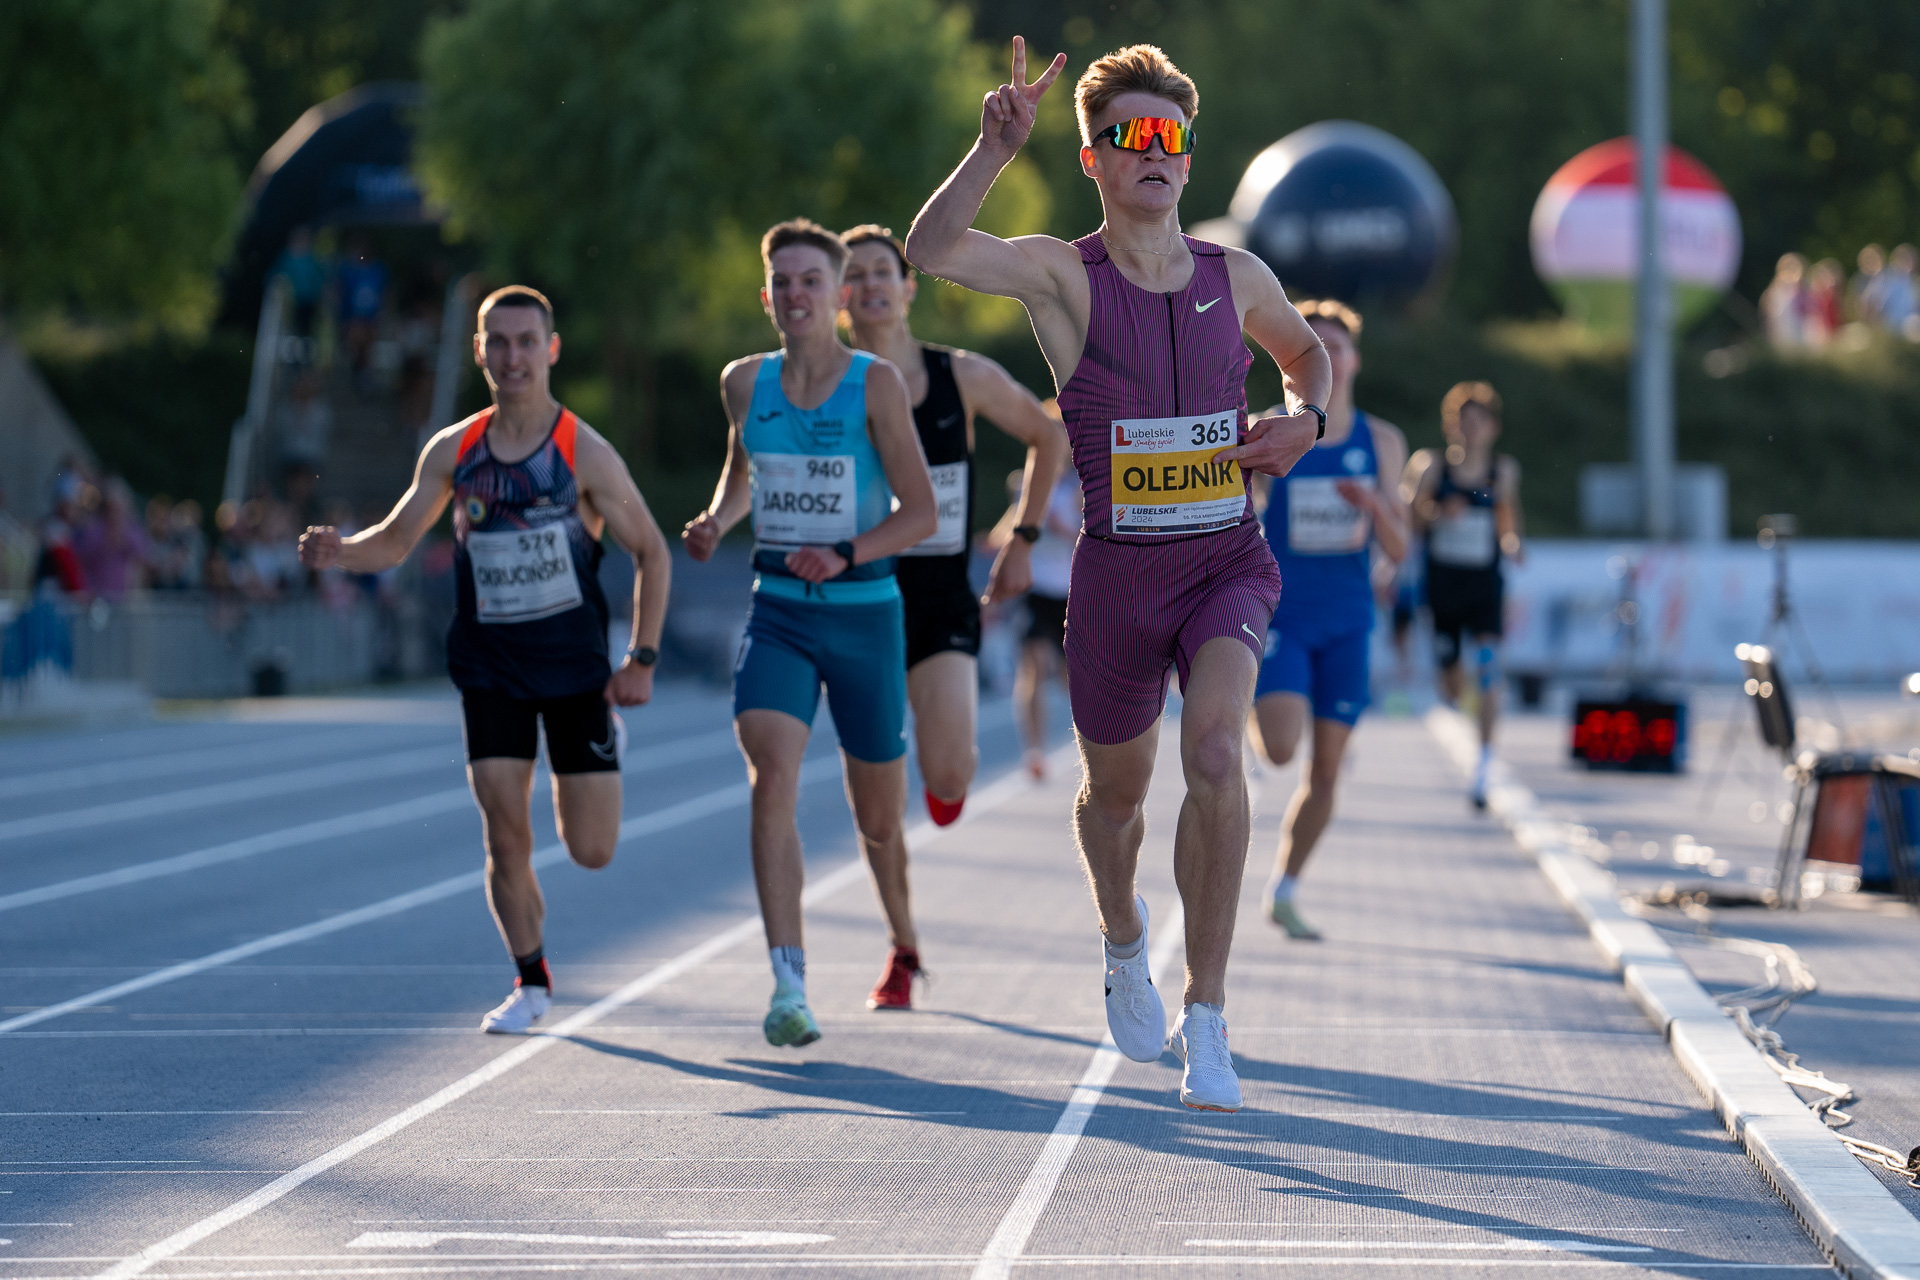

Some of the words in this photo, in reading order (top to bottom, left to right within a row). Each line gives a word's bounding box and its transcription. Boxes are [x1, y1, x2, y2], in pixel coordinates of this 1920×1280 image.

[1191, 418, 1231, 446] 365
[805, 458, 845, 479] 940
[1122, 459, 1234, 492] OLEJNIK
[763, 489, 843, 514] JAROSZ
[1131, 506, 1178, 515] LUBELSKIE
[1131, 515, 1153, 523] 2024
